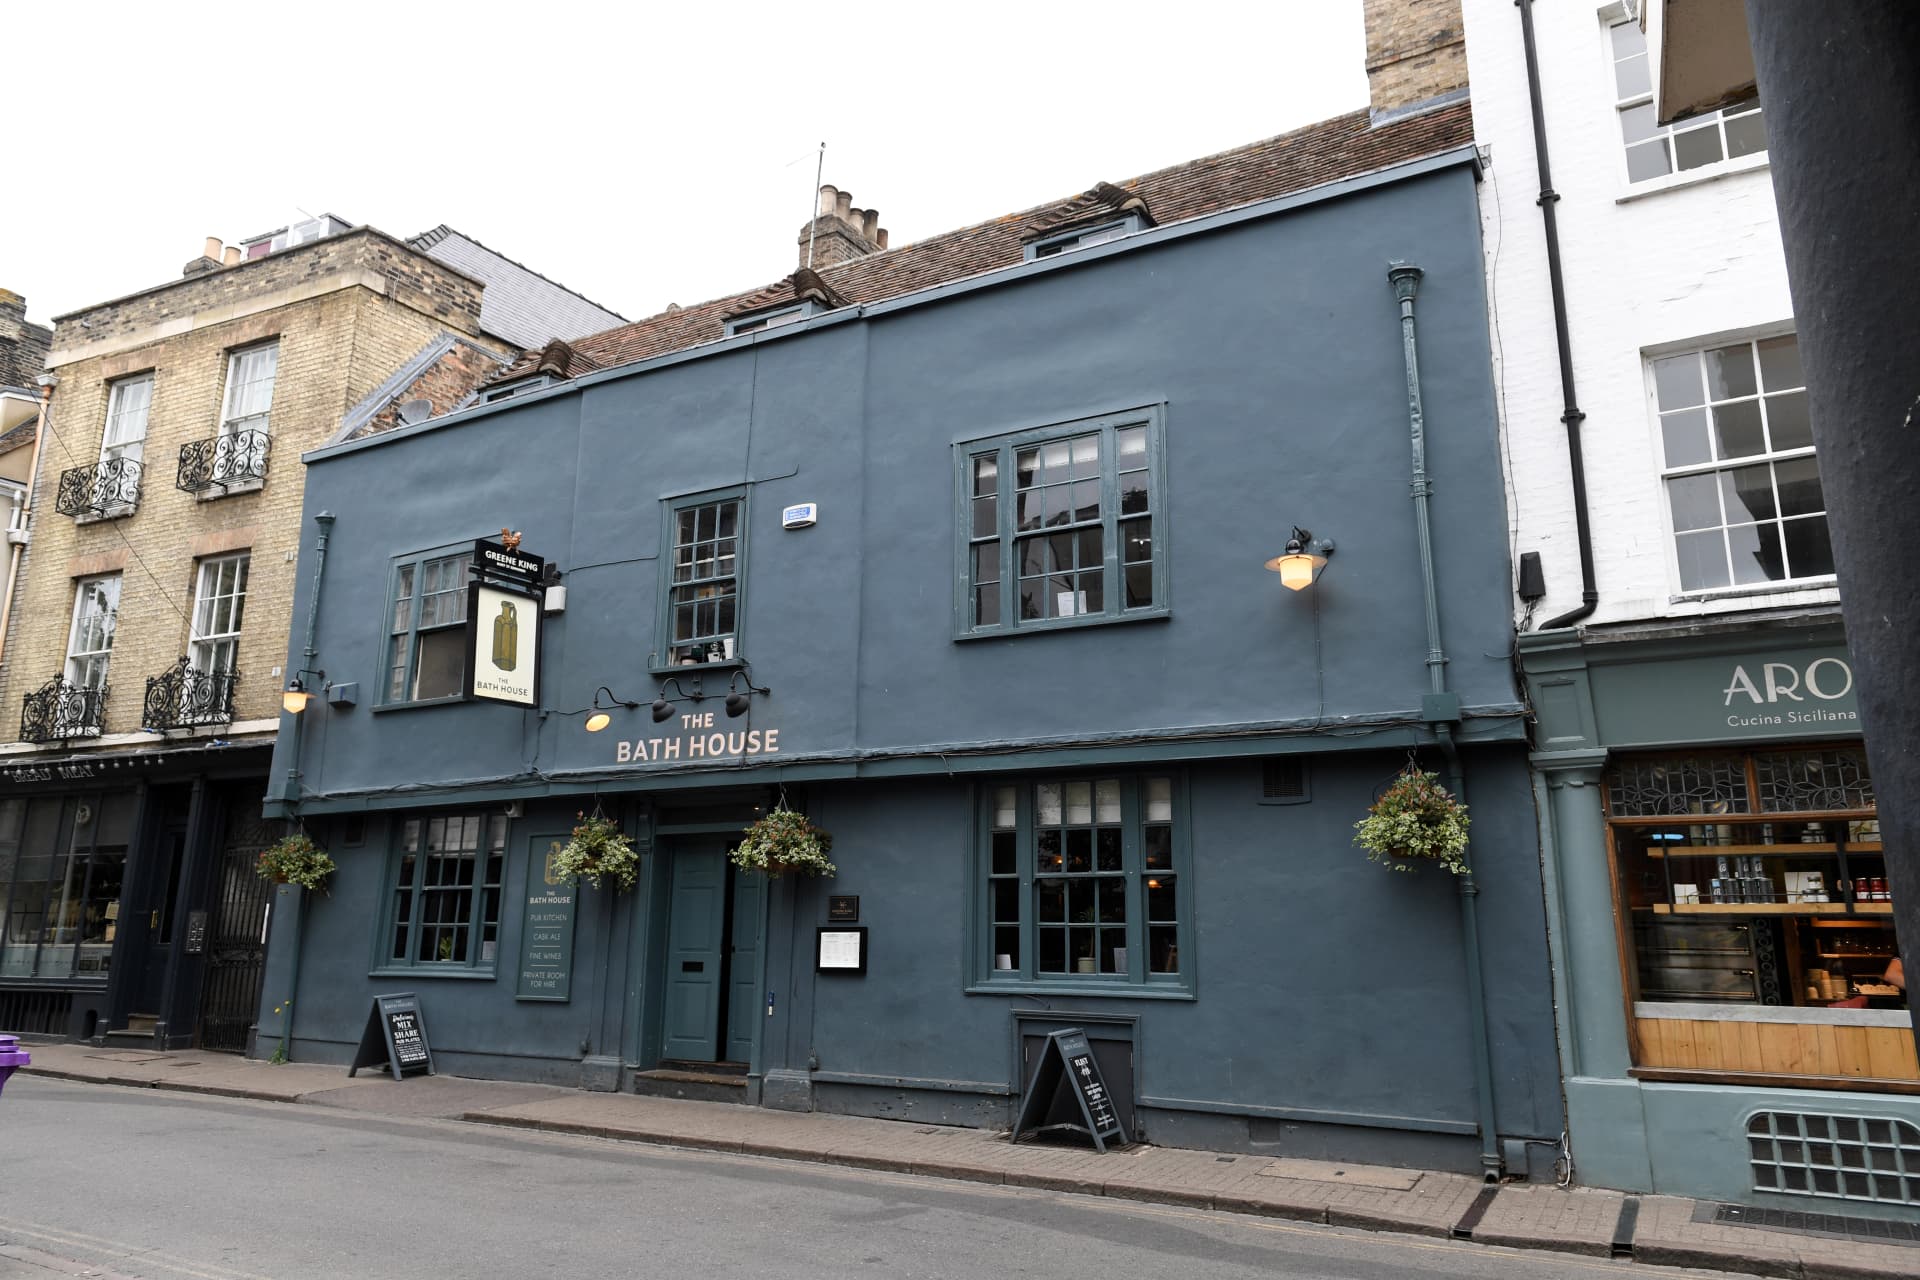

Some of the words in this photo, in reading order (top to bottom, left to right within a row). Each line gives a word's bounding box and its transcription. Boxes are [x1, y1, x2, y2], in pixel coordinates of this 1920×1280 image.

[485, 550, 517, 566] GREENE
[518, 559, 538, 572] KING
[498, 677, 509, 685] THE
[477, 680, 499, 692] BATH
[500, 685, 529, 697] HOUSE
[682, 713, 714, 730] THE
[1727, 714, 1782, 727] Cucina
[1787, 709, 1857, 723] Siciliana
[616, 737, 681, 762] BATH
[688, 729, 780, 757] HOUSE
[547, 896, 571, 904] HOUSE
[543, 913, 567, 921] KITCHEN
[550, 933, 561, 941] ALE
[529, 952, 542, 960] FINE
[543, 952, 562, 960] WINES
[546, 971, 566, 980] ROOM
[397, 1021, 411, 1029] MIX
[394, 1030, 418, 1039] SHARE
